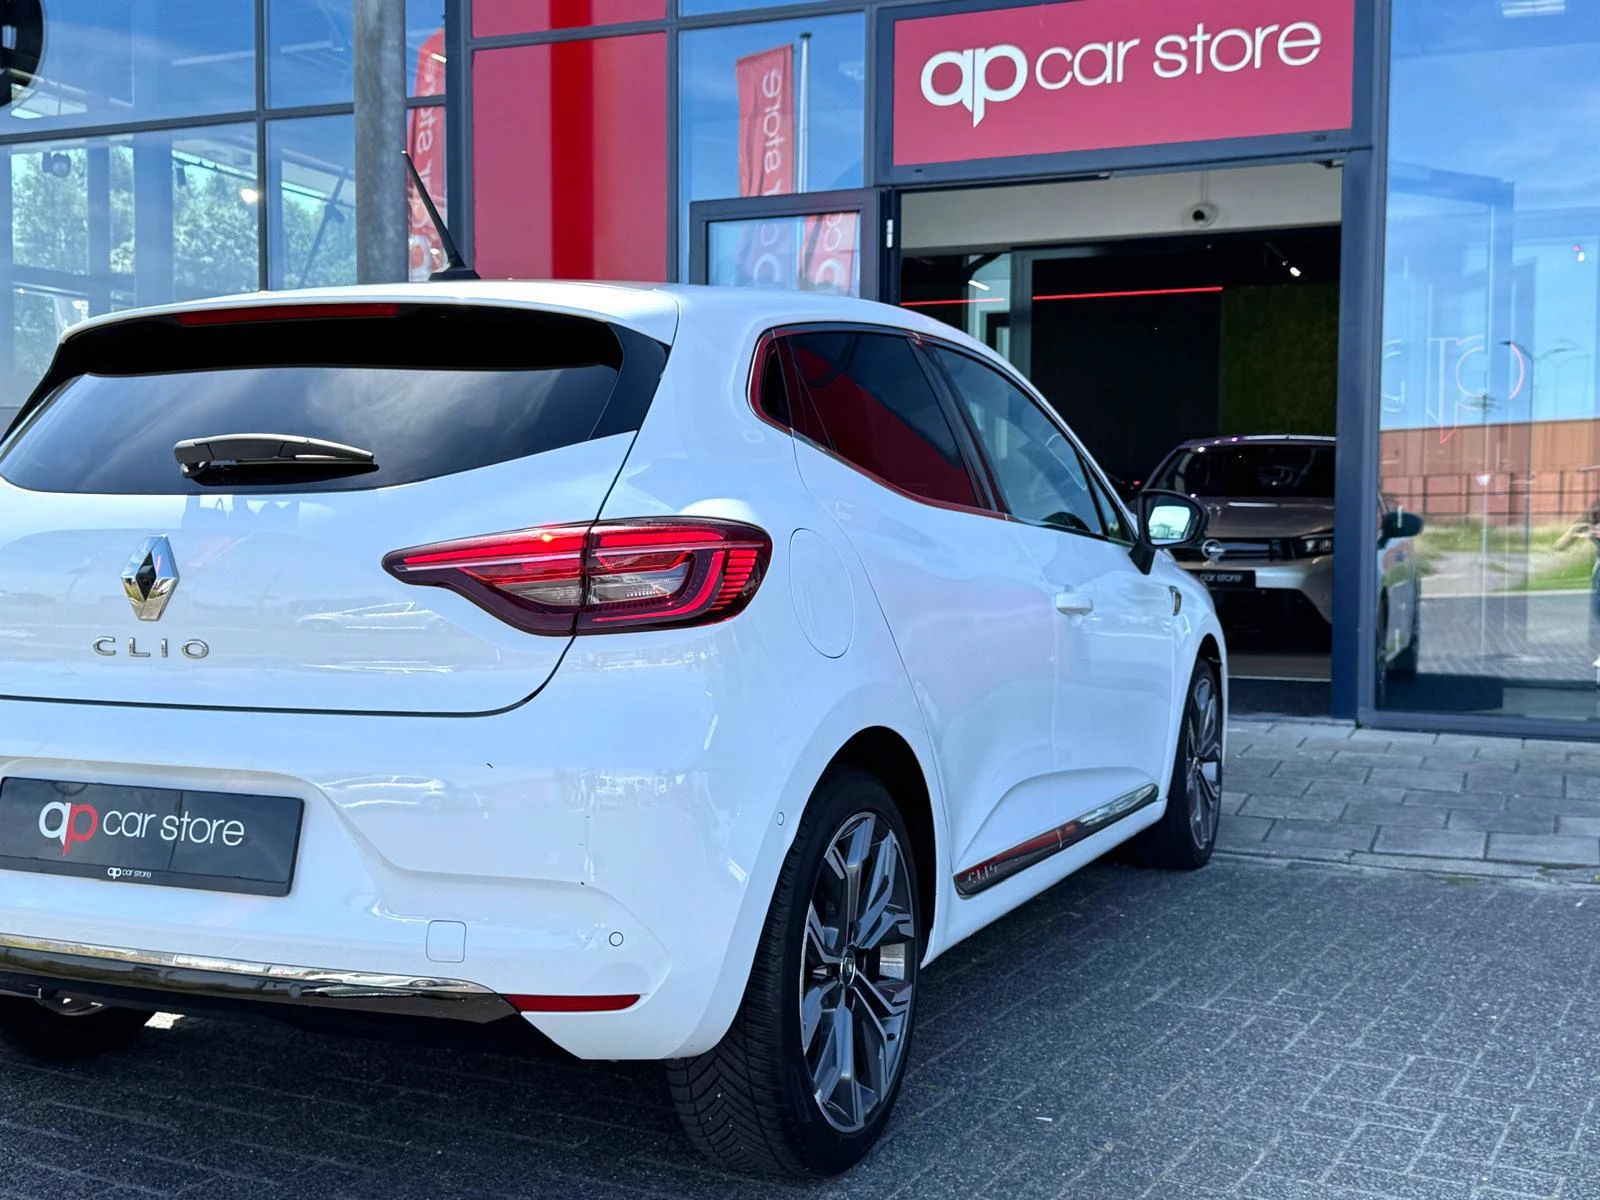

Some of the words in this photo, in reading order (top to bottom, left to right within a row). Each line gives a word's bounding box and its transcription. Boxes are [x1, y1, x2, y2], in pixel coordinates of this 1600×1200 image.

[1035, 38, 1140, 91] car
[1153, 21, 1321, 79] store
[93, 636, 209, 659] CLIO
[102, 810, 157, 838] car
[160, 811, 245, 846] store
[134, 870, 152, 878] store
